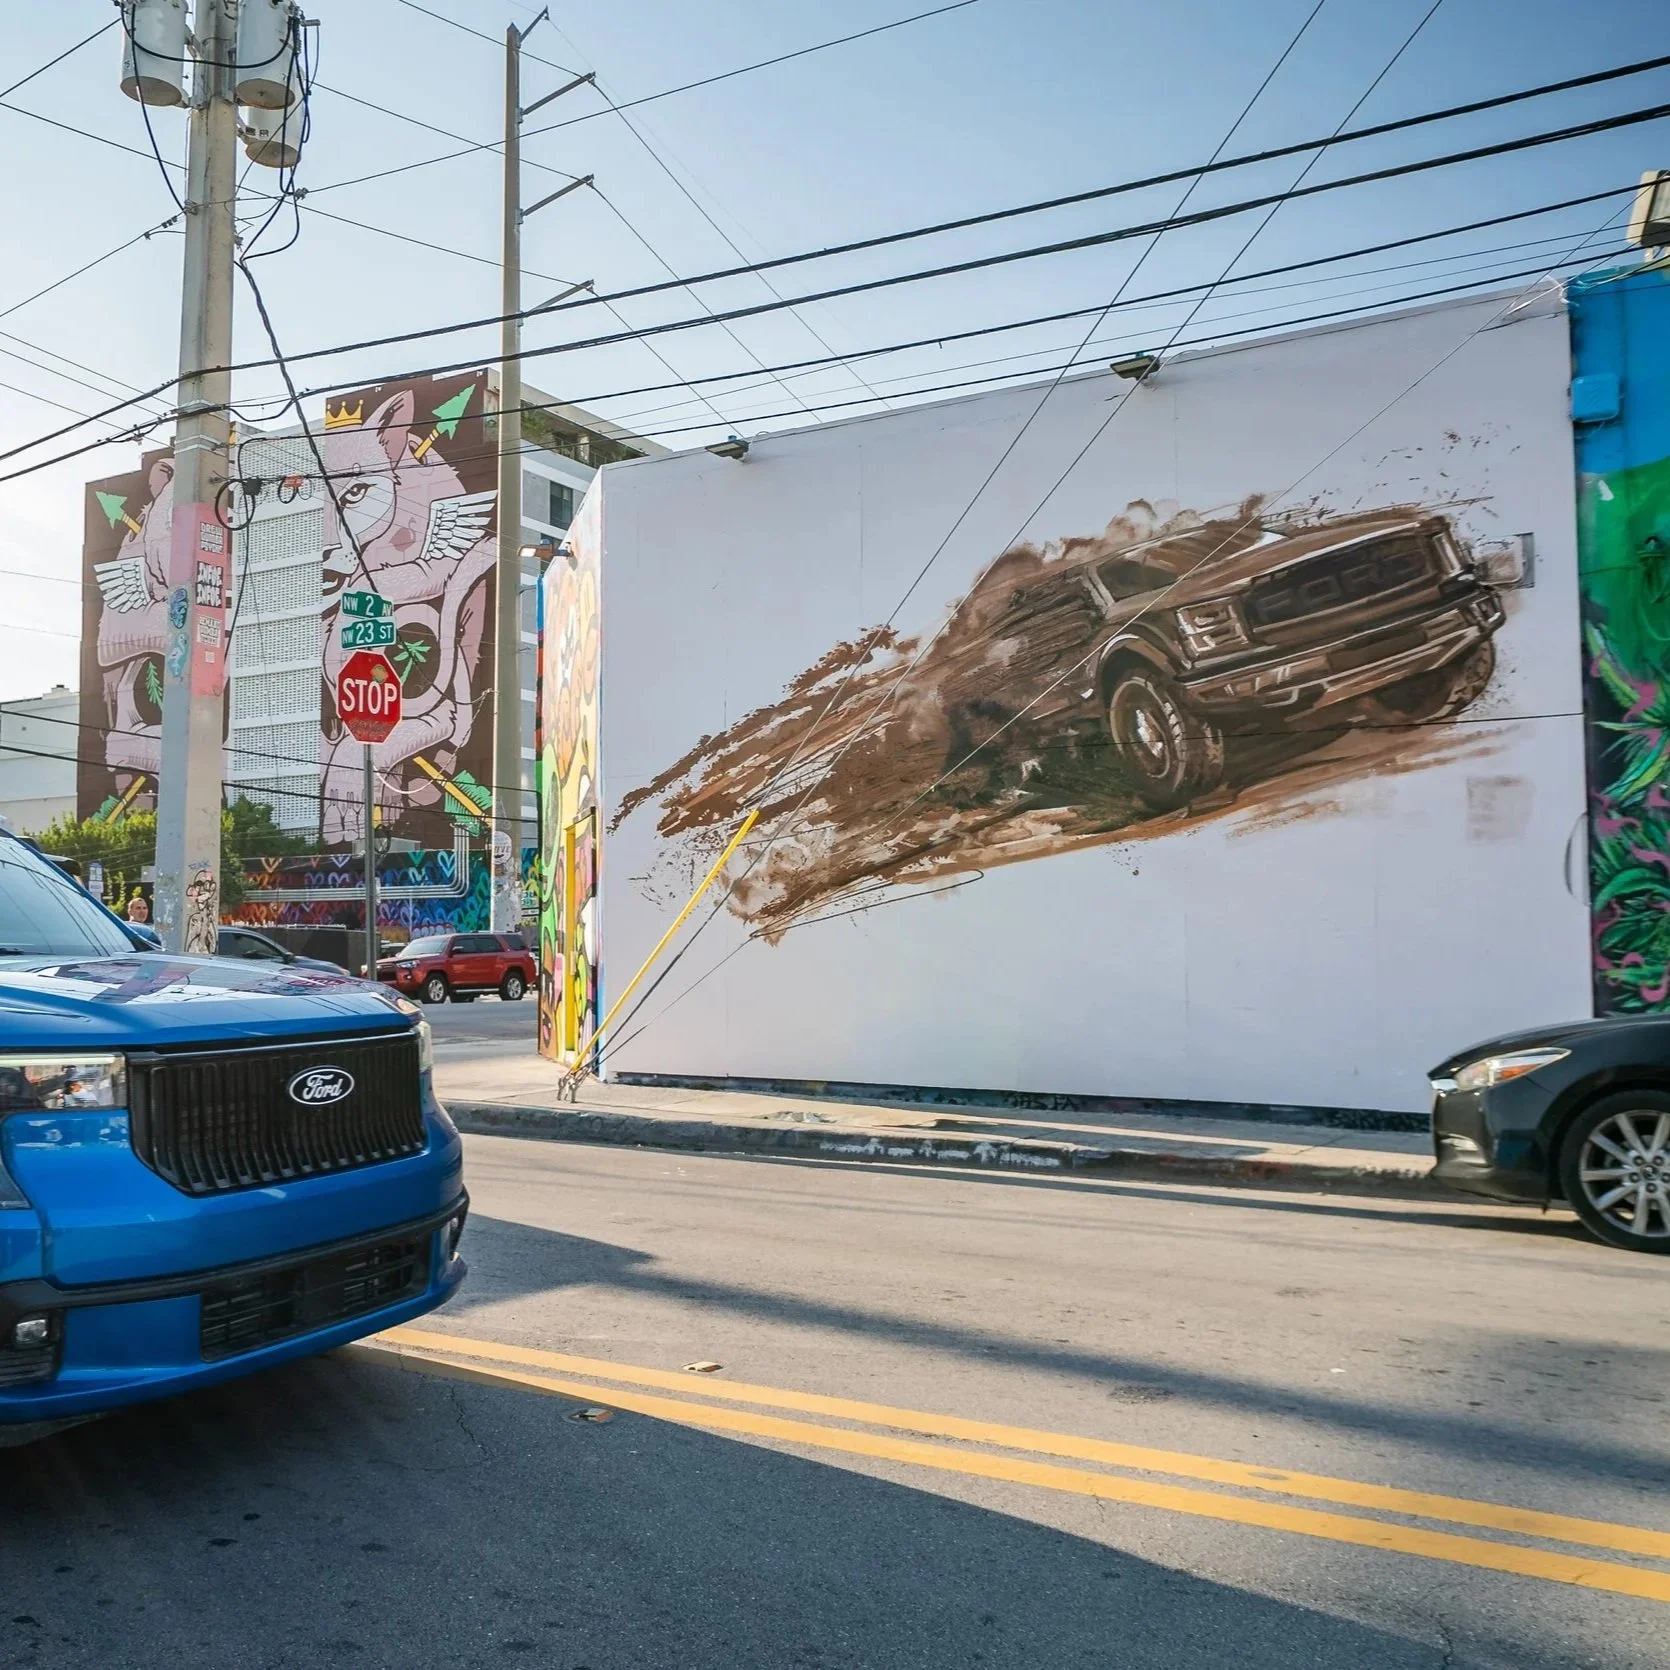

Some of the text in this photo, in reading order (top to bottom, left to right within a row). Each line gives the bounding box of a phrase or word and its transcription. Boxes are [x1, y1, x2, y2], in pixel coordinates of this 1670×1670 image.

[343, 596, 358, 611] NW
[365, 595, 374, 616] 2
[342, 622, 393, 644] NW 23 ST
[341, 677, 397, 715] STOP
[302, 1074, 343, 1100] Ford
